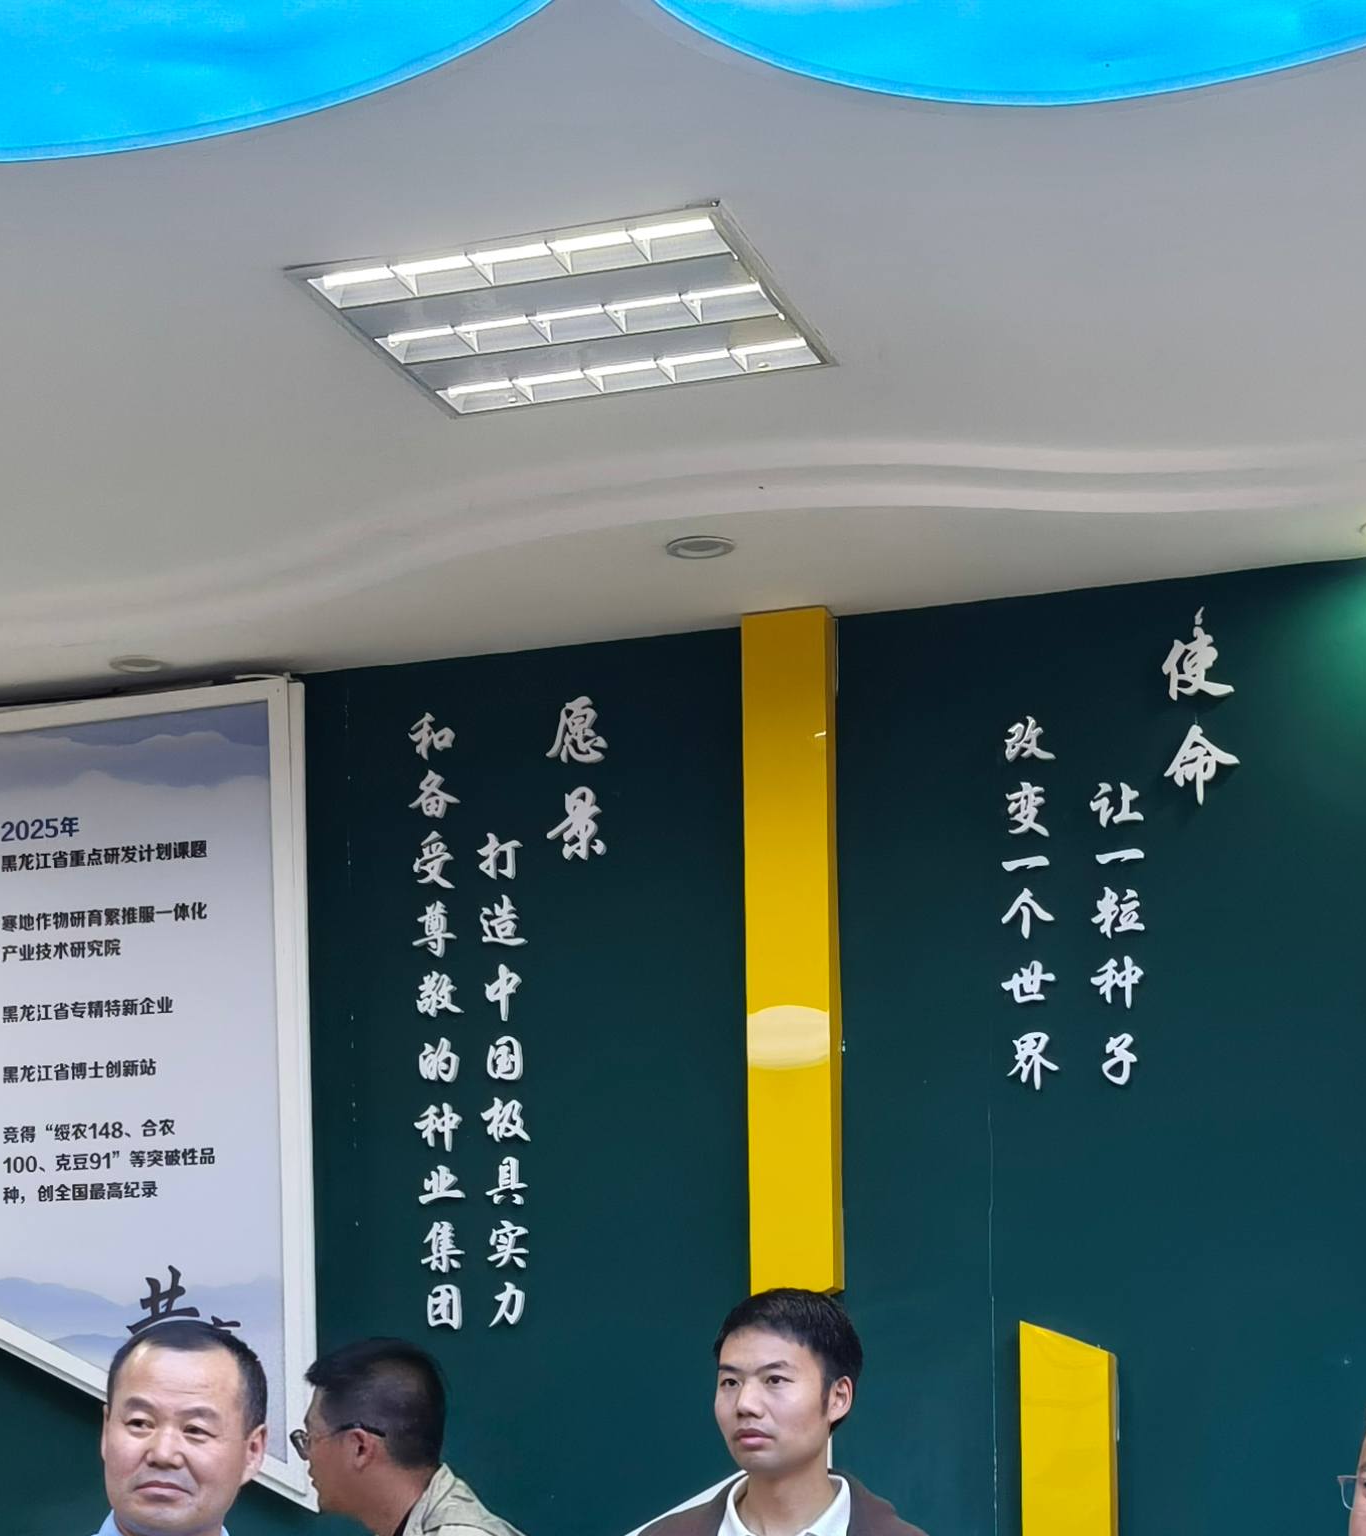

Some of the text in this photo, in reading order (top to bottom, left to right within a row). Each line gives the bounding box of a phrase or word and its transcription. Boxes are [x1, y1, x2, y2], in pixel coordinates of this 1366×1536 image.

[1161, 606, 1240, 806] 使命
[545, 695, 609, 861] 愿景
[1, 816, 80, 842] 2025年
[1, 840, 208, 872] 黑龙江省重点研发计划课题
[2, 901, 208, 932] 寒地作物研育繁推服一体化
[1001, 716, 1059, 1090] 改变一个世界
[1089, 783, 1145, 1086] 让一粒种子
[2, 938, 121, 963] 产业技术研究院
[2, 996, 174, 1023] 黑龙江省专精特新企业
[3, 1058, 157, 1084] 黑龙江省博士创新站
[476, 833, 532, 1328] 打造中国极具实力
[3, 1180, 159, 1204] 种，创全国最高纪录
